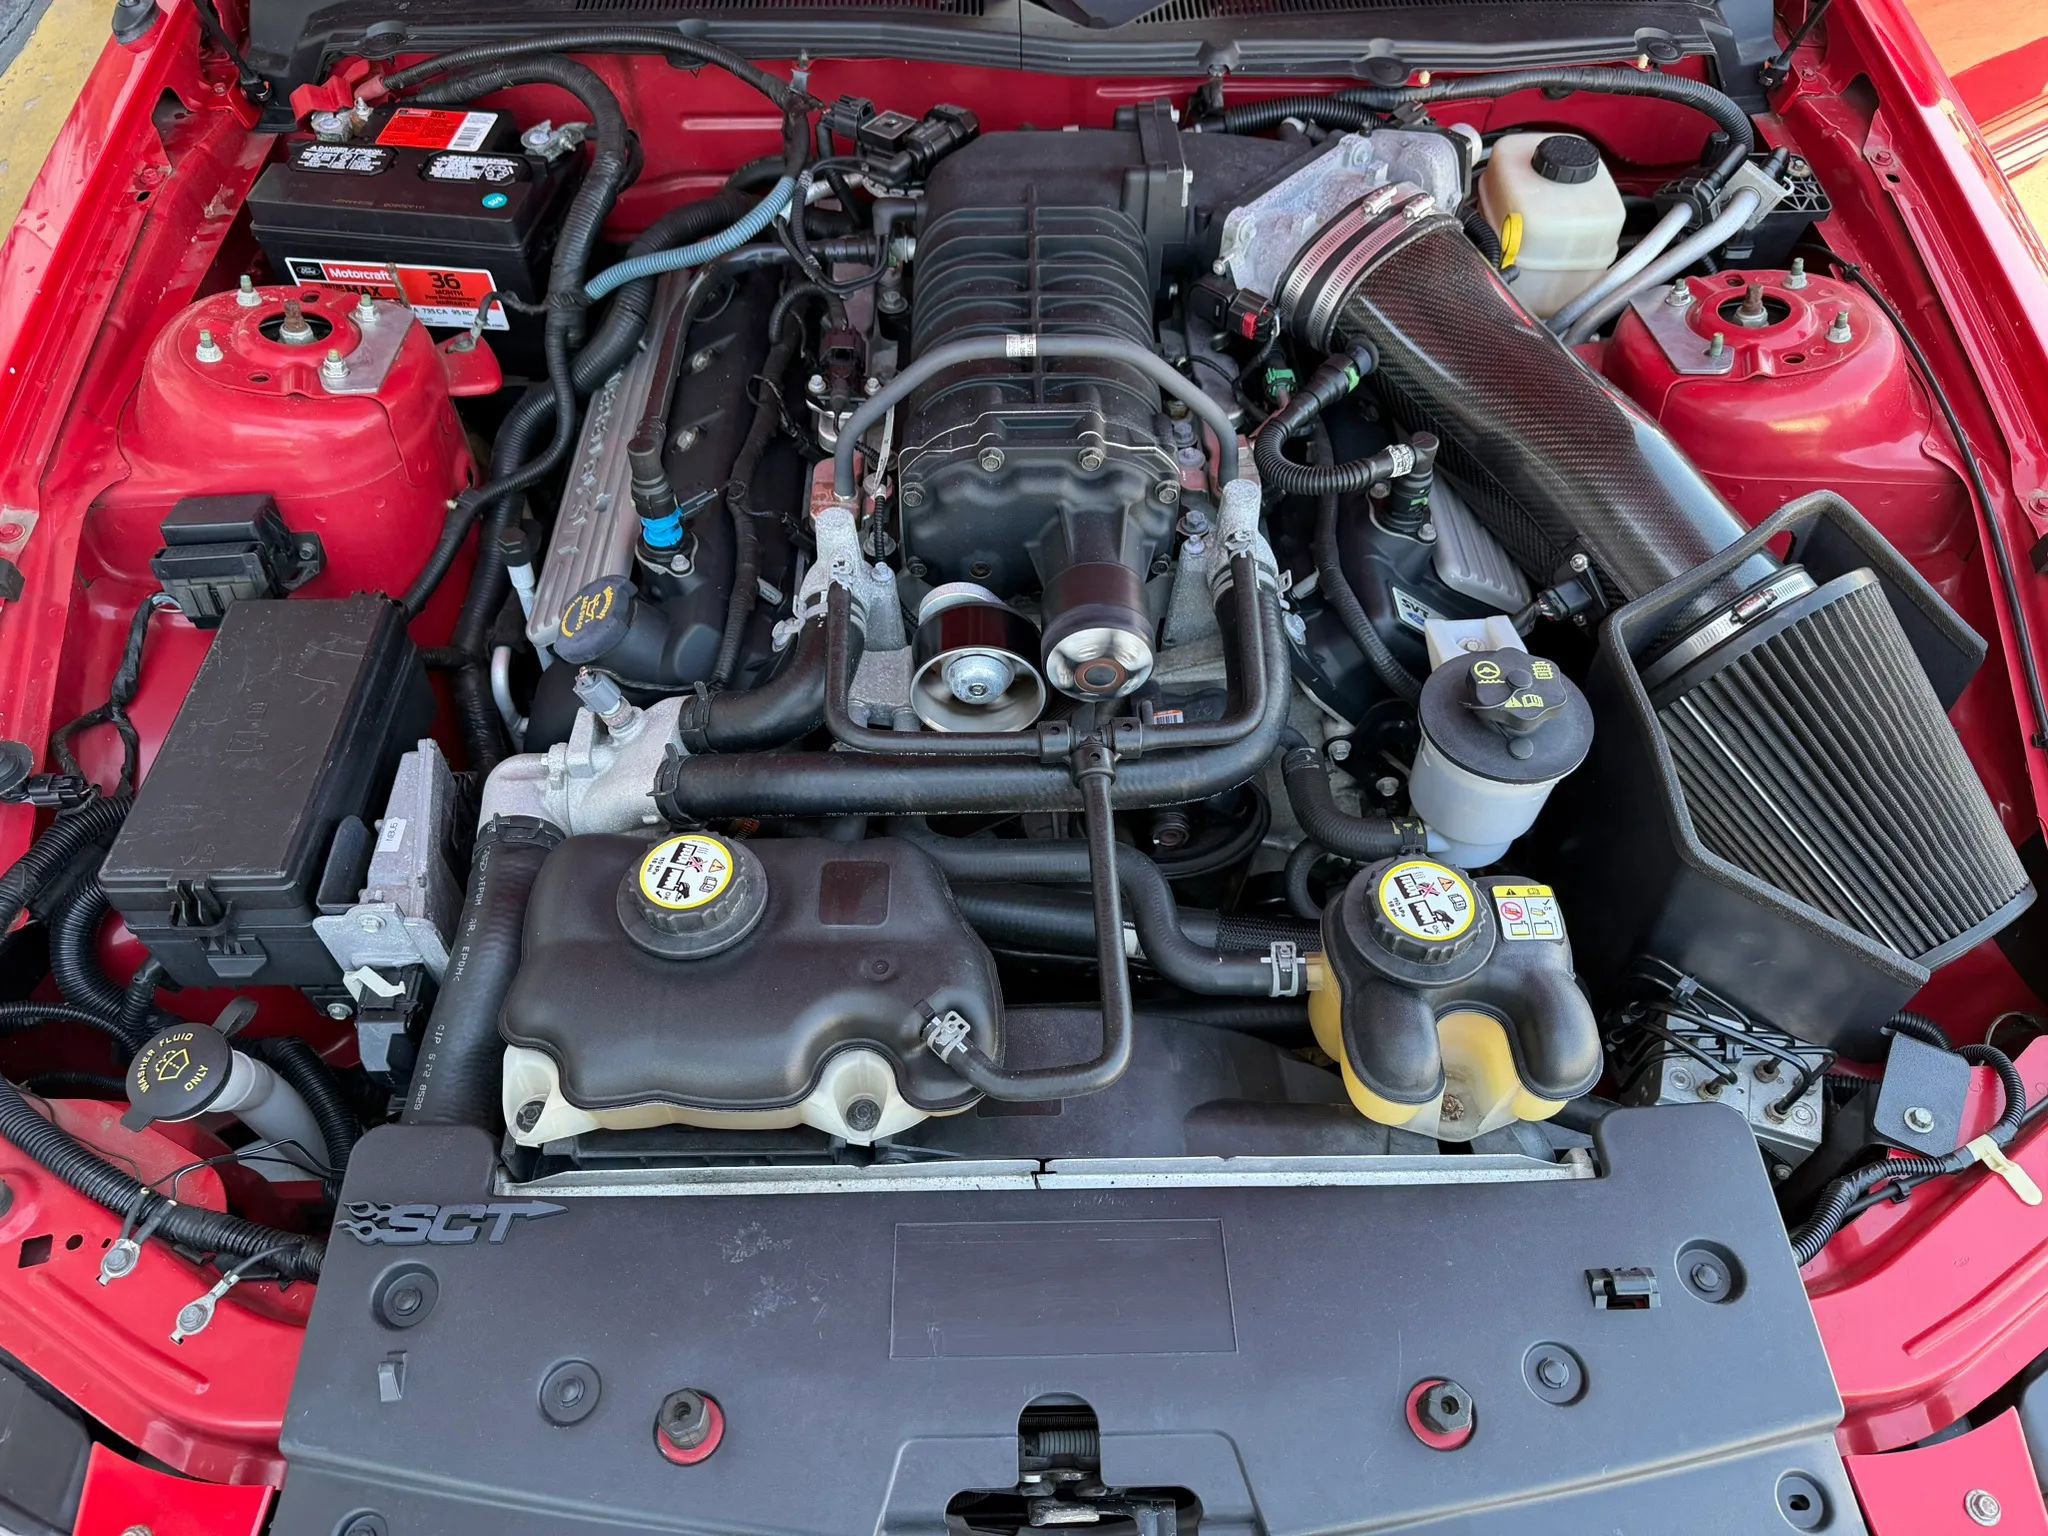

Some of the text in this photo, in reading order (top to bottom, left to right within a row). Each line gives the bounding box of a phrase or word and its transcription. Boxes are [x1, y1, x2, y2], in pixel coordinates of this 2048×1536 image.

[328, 268, 391, 281] Motorcraft
[427, 271, 461, 290] 36
[434, 289, 463, 297] MONTH
[1401, 598, 1429, 619] SVT
[663, 891, 672, 901] OK
[434, 1024, 446, 1045] CIP
[137, 1032, 194, 1093] WASHER FLUID
[184, 1064, 209, 1092] ONLY
[378, 1202, 568, 1246] SCT
